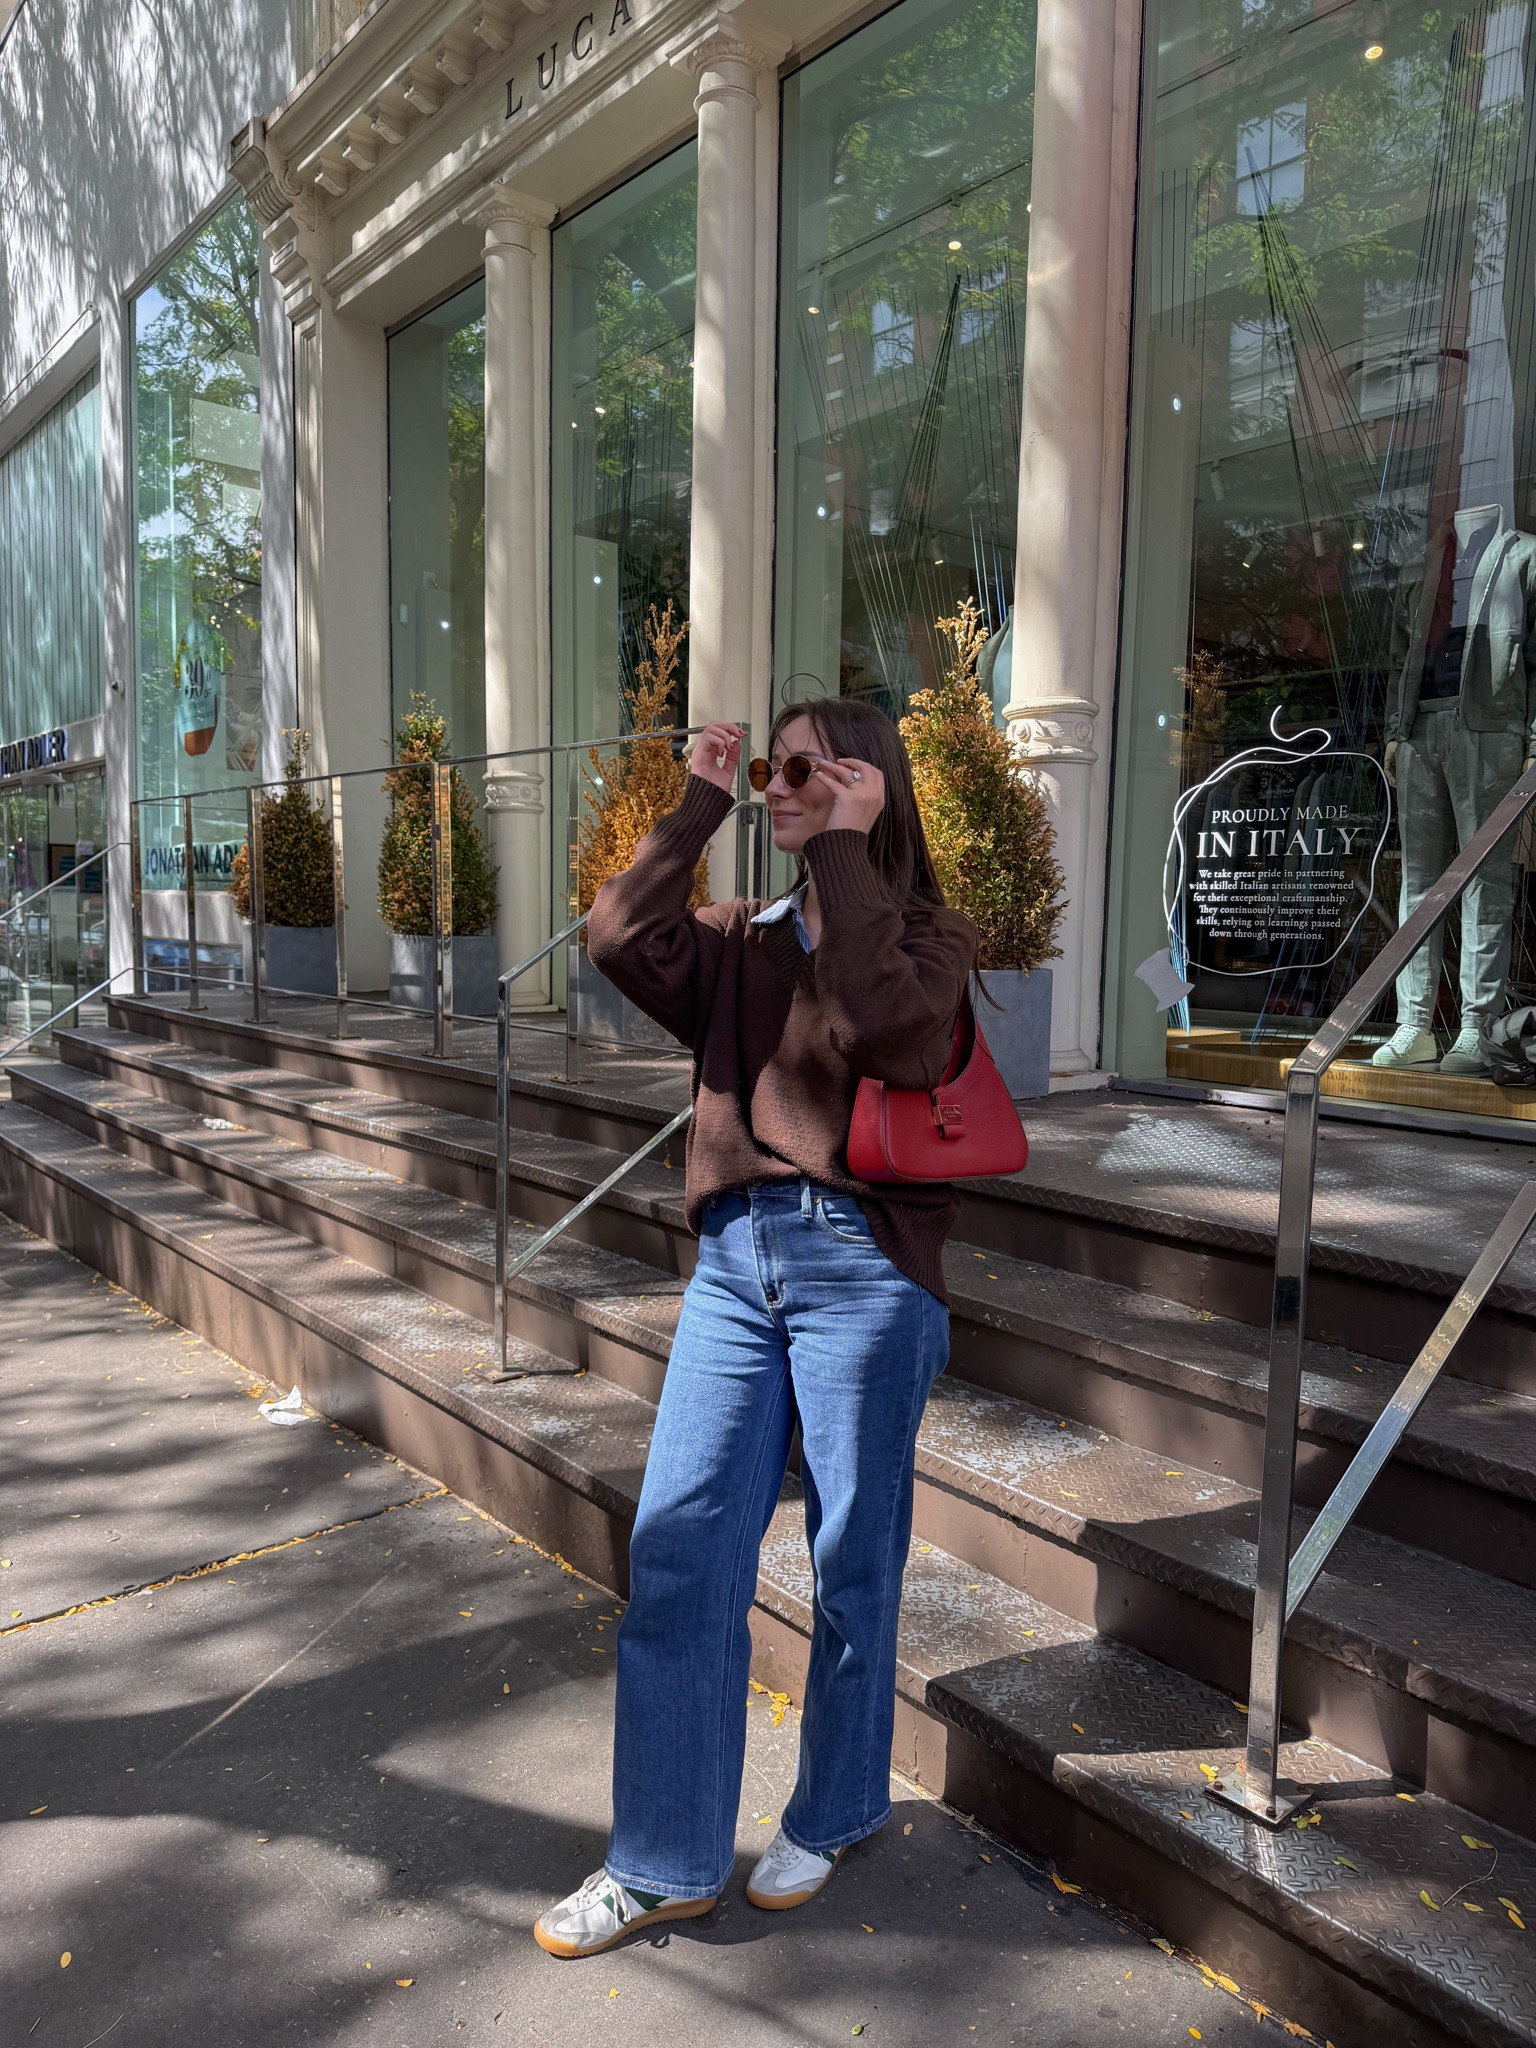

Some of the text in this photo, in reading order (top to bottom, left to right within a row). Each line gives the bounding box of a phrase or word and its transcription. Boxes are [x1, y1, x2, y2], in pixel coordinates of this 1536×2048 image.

[505, 0, 632, 119] LUCA
[0, 730, 67, 775] HAN ADLER
[1211, 805, 1348, 824] PROUDLY MADE
[1196, 829, 1361, 858] IN ITALY
[1199, 868, 1345, 880] We take great pride in partnering
[1189, 879, 1354, 890] with skilled Italian artisans renowned
[1193, 893, 1348, 904] for their exceptional craftsmanship.
[1199, 905, 1339, 916] They continuously improve their
[1196, 917, 1220, 926] skills,
[1223, 917, 1251, 928] relying
[1268, 918, 1308, 929] learnings
[1311, 918, 1341, 929] passed
[1210, 929, 1324, 941] down through generations.
